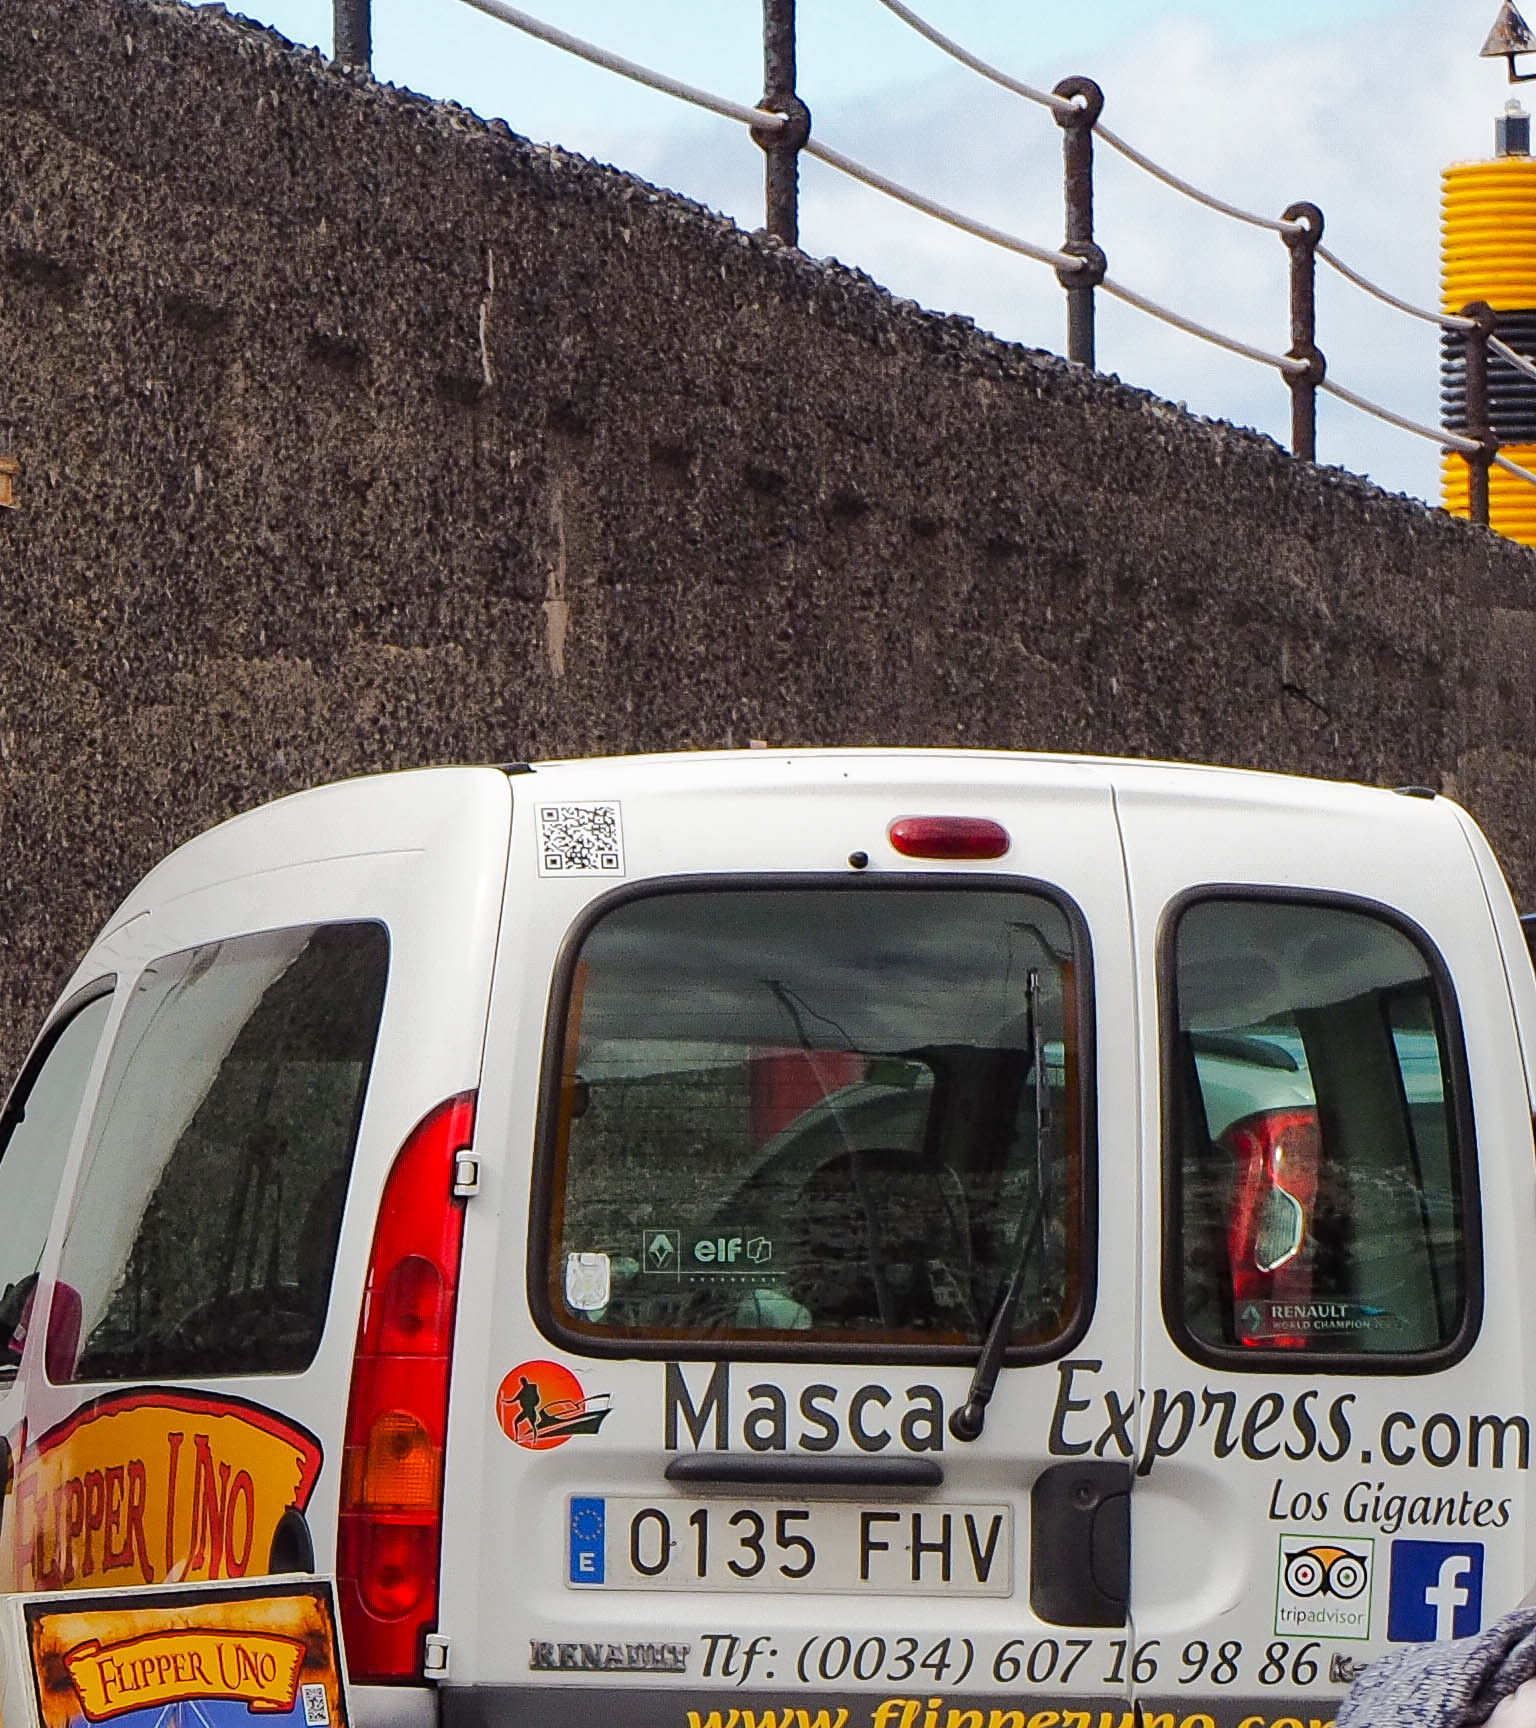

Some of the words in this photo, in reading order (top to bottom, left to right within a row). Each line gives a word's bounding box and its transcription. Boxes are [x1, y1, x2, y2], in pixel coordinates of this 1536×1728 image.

[694, 1238, 742, 1262] elf
[1271, 1304, 1350, 1318] RENAULT
[664, 1362, 946, 1454] Masca
[1047, 1359, 1532, 1478] Express.com
[1268, 1478, 1329, 1521] Los
[1344, 1481, 1513, 1534] Gigantes
[579, 1551, 596, 1573] E
[629, 1509, 816, 1580] 0135
[858, 1512, 1004, 1584] FHV
[1280, 1606, 1365, 1626] tripadvisor
[98, 1650, 208, 1707] FLIPPER
[215, 1642, 278, 1693] UNO
[529, 1638, 691, 1674] RENAULT
[699, 1634, 778, 1682] Tlf:
[796, 1636, 975, 1687] (0034)
[992, 1639, 1092, 1686] 607
[1102, 1638, 1160, 1686] 16
[1175, 1640, 1244, 1688] 98
[1256, 1641, 1321, 1686] 86
